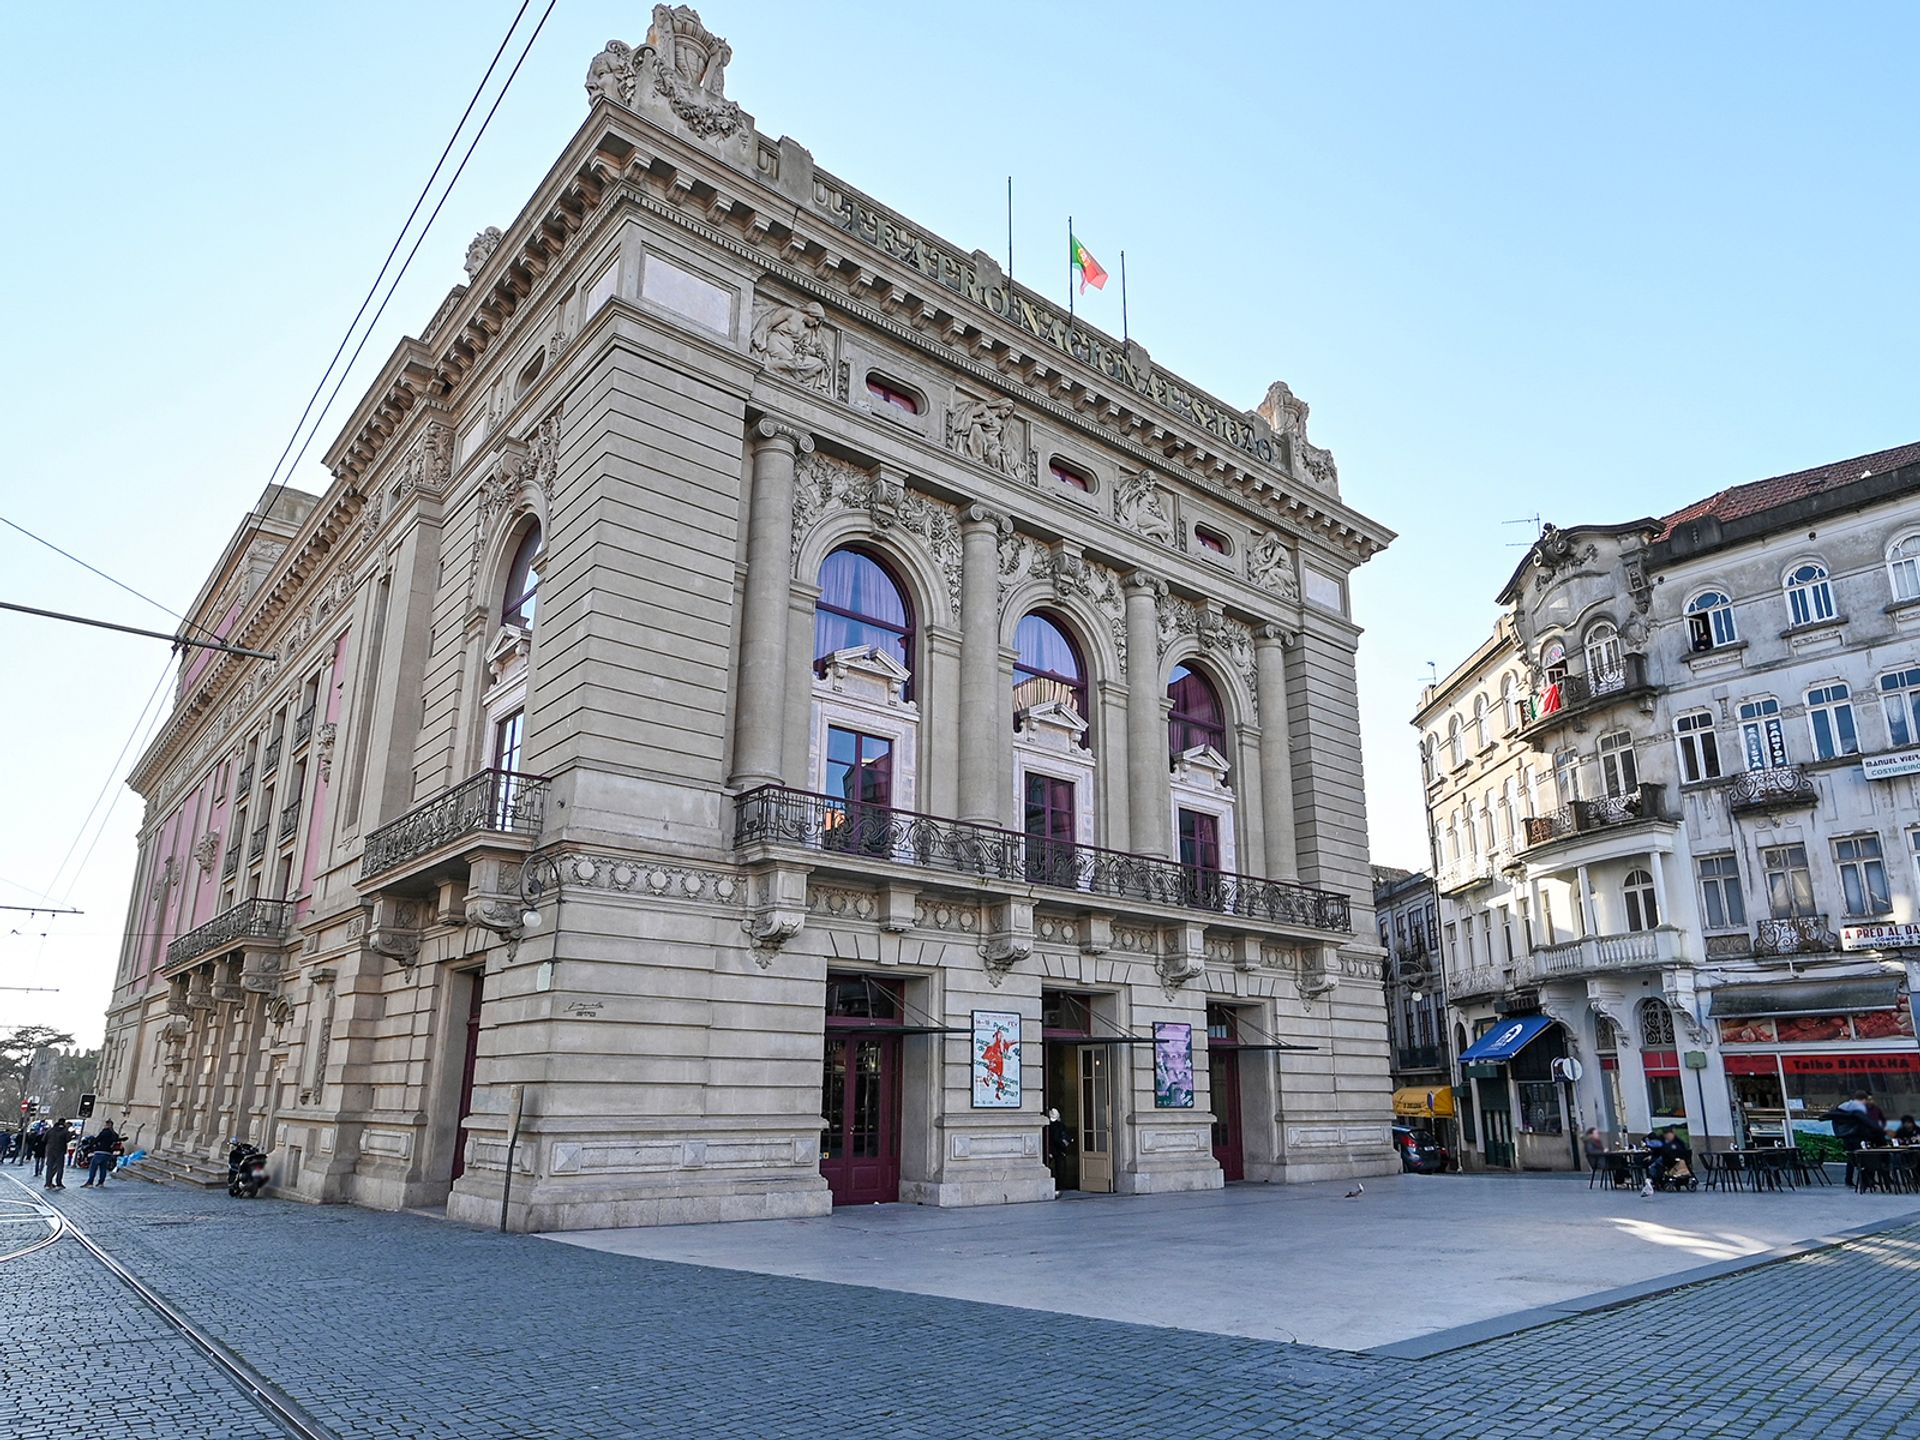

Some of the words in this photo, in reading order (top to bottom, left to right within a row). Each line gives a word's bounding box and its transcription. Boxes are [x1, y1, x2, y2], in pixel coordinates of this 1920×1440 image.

[846, 201, 1010, 317] TEATRO
[1017, 297, 1191, 420] NACIONAL
[1769, 722, 1784, 765] SANTOS
[1865, 758, 1898, 767] MANUEL
[1845, 930, 1851, 940] A
[1794, 1060, 1833, 1069] Talho
[1838, 1058, 1910, 1069] BATALHA
